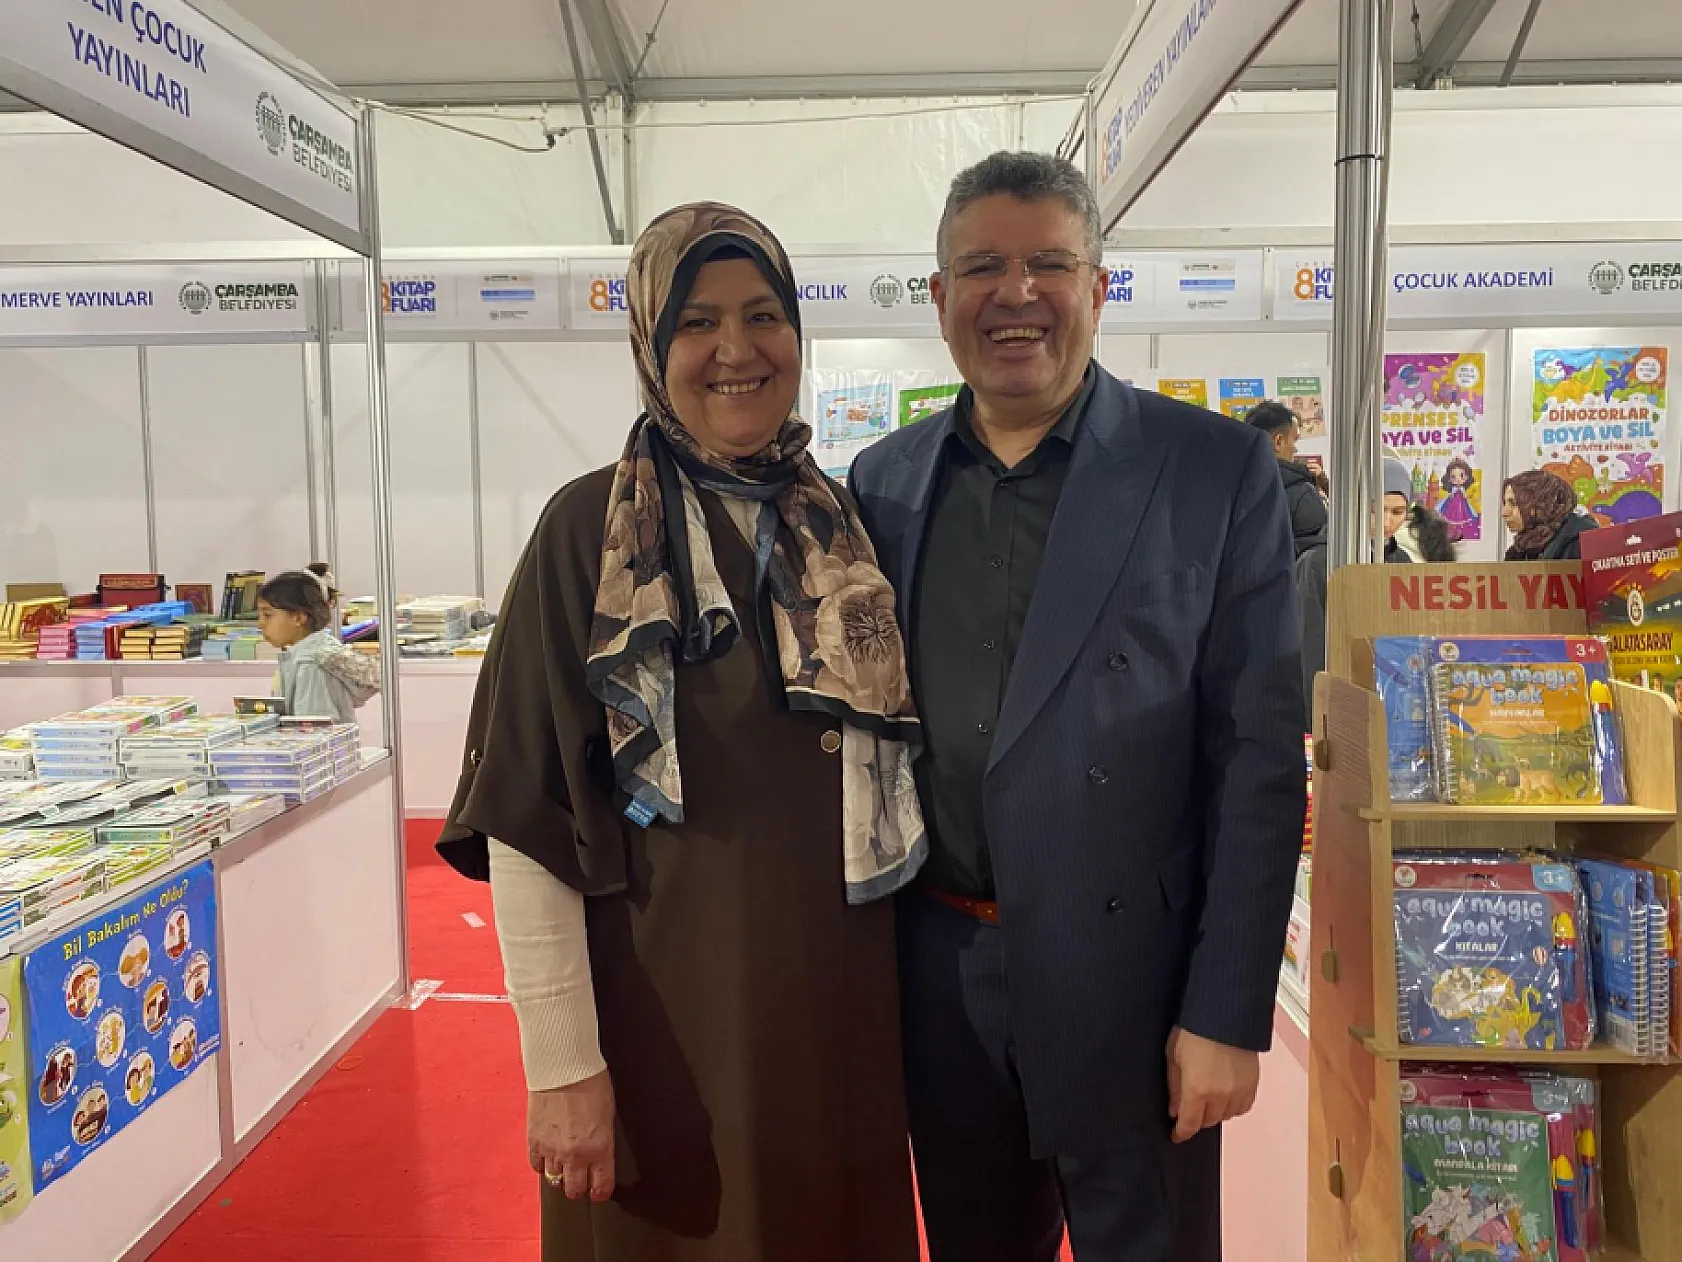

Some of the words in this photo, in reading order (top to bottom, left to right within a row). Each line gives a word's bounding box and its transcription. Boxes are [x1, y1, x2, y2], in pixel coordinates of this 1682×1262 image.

[131, 1, 206, 73] ÇOCUK
[67, 22, 190, 118] YAYINLARI
[1393, 272, 1458, 293] ÇOCUK
[1463, 266, 1554, 288] AKADEMİ
[1, 292, 61, 308] MERVE
[66, 291, 153, 307] YAYINLARI
[215, 282, 298, 299] ÇARŞAMBA
[391, 297, 436, 313] FUARI
[1549, 405, 1650, 421] DİNOZORLAR
[1543, 425, 1597, 443] BOYA
[1490, 686, 1543, 705] book
[63, 934, 82, 961] Bil
